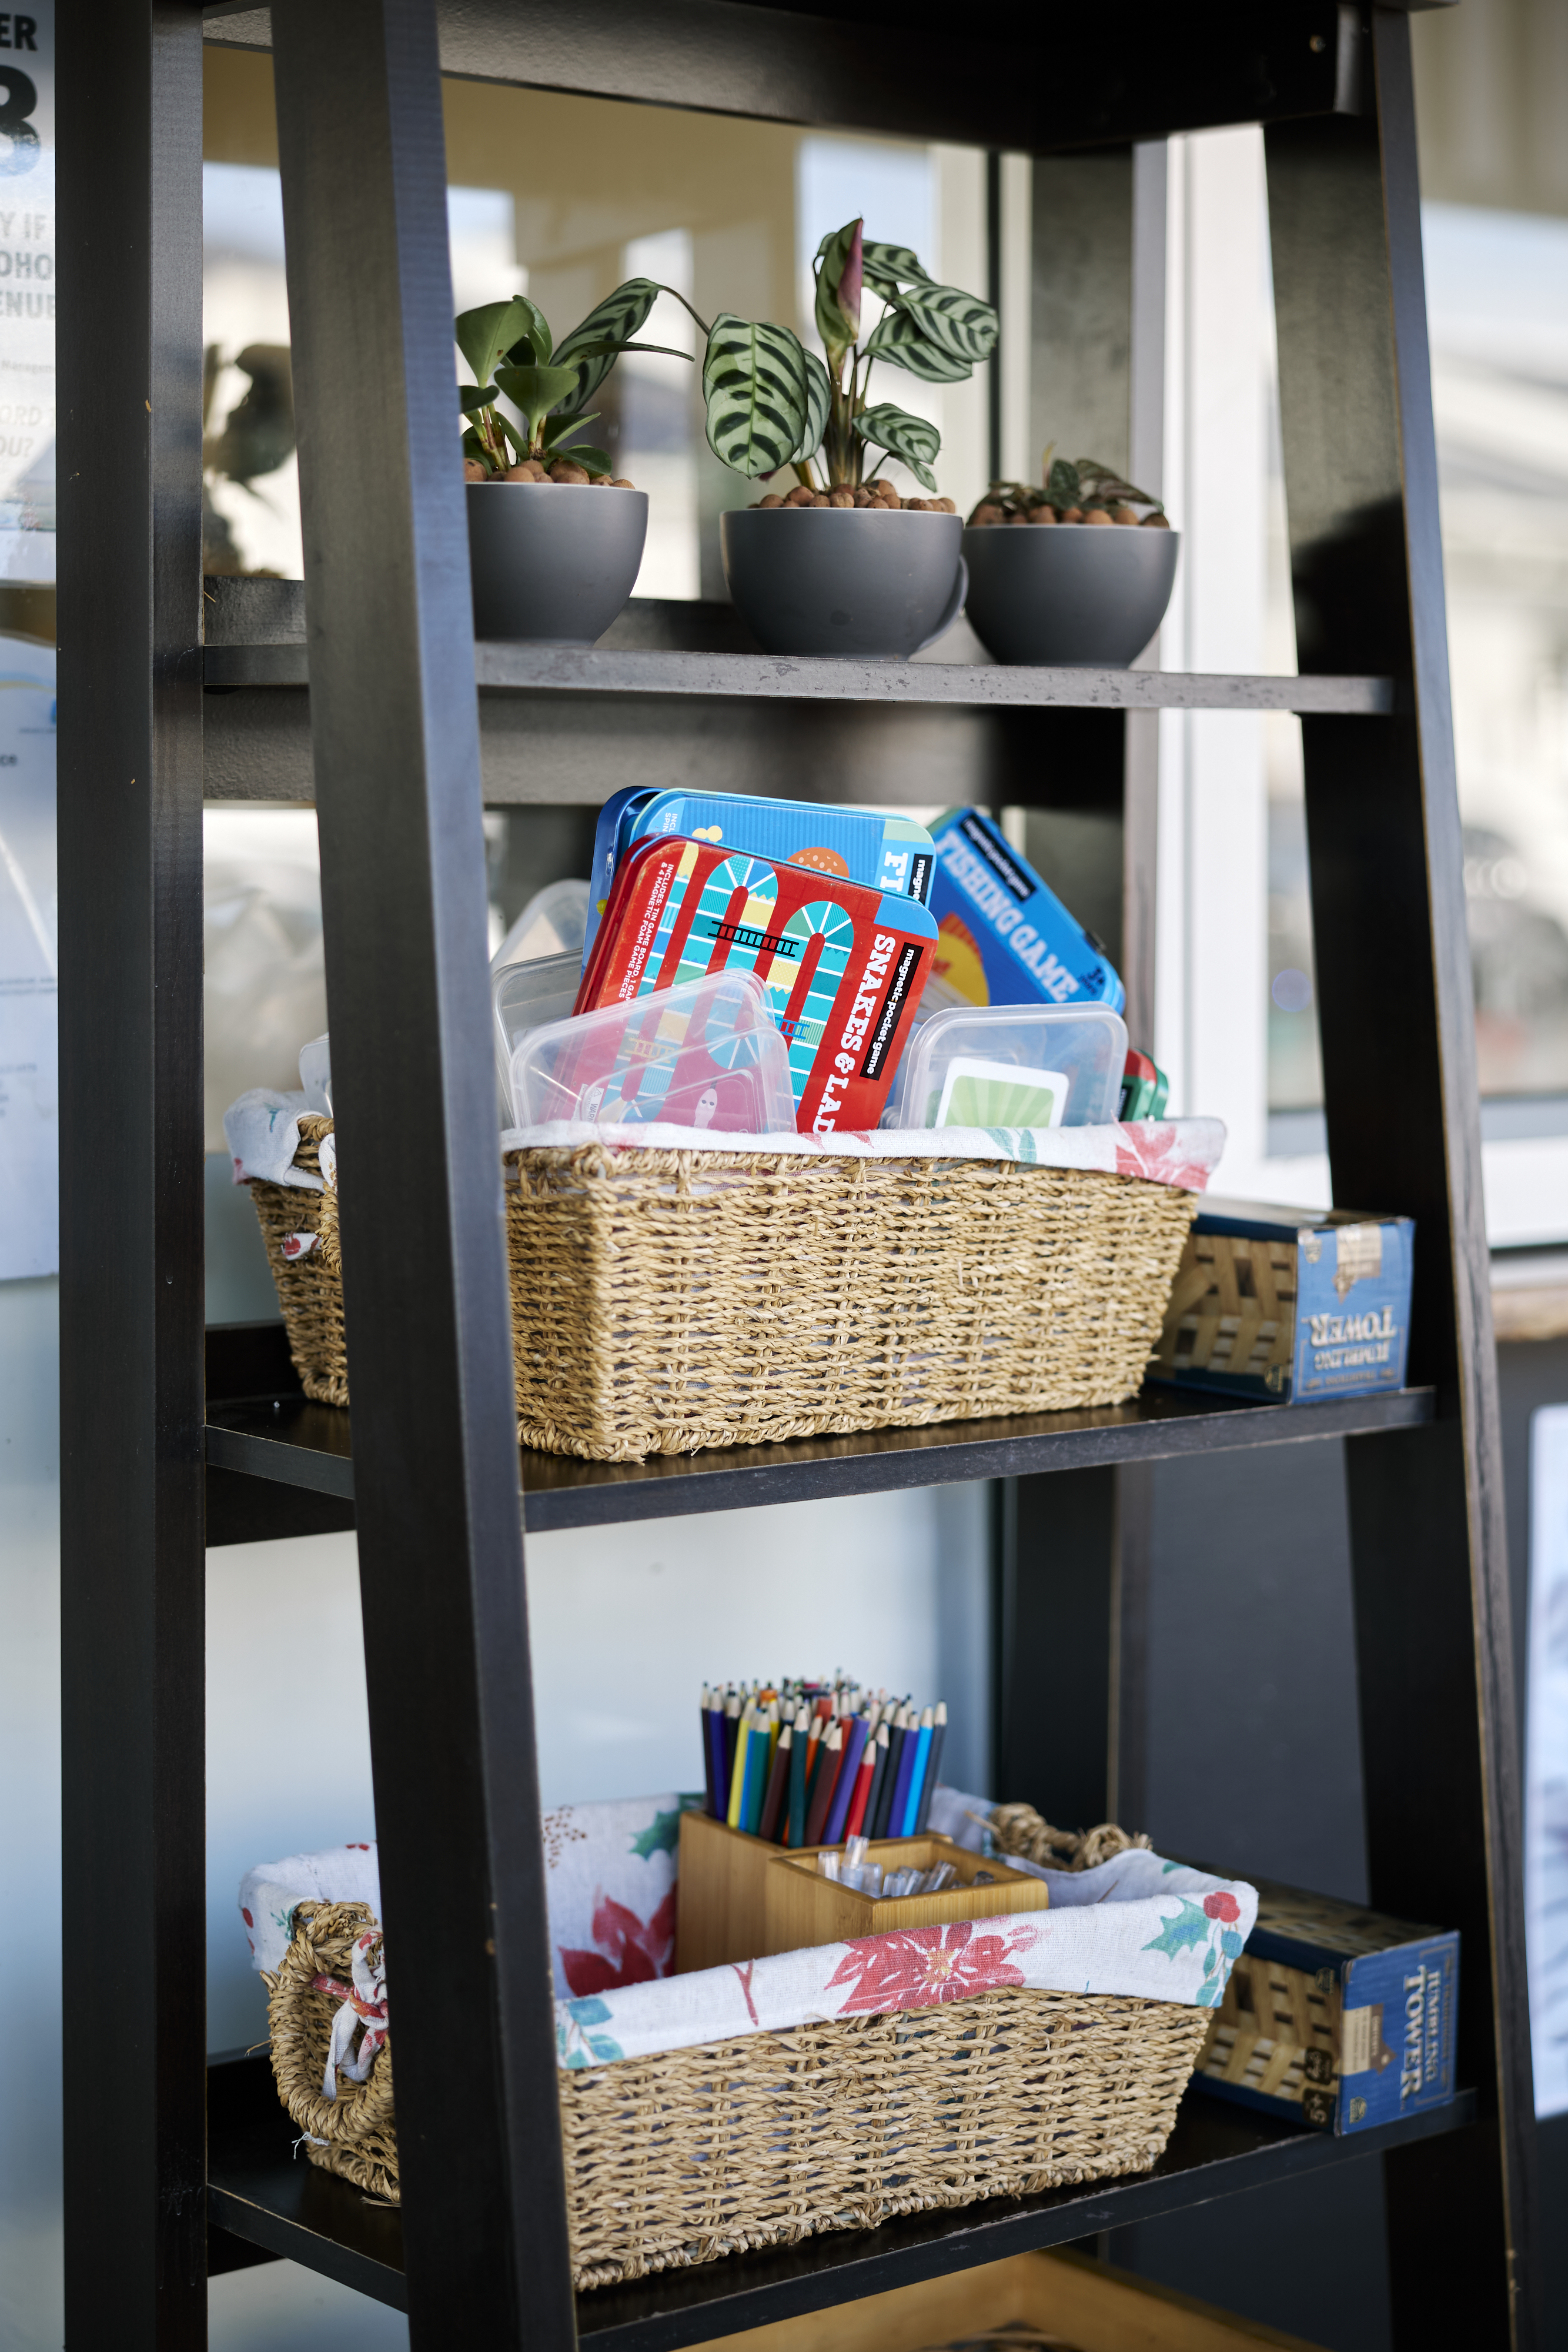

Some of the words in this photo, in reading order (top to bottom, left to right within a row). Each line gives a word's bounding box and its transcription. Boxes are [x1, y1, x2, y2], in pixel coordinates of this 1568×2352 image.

[663, 813, 671, 833] SPIN
[655, 864, 674, 906] INCLUDES:
[880, 851, 908, 892] FI
[644, 877, 663, 919] MAGNETIC
[650, 908, 660, 921] TIN
[935, 830, 1025, 936] FISHING
[1008, 924, 1080, 1004] GAME
[636, 920, 648, 944] FOAM
[642, 922, 654, 946] GAME
[628, 945, 640, 969] GAME
[891, 948, 915, 1003] magnetic
[618, 970, 633, 998] PIECES
[841, 933, 896, 1051] SNAKES
[877, 1001, 897, 1043] pocket
[834, 1052, 855, 1074] &
[867, 1041, 882, 1074] game
[1310, 1304, 1397, 1347] TOWER
[1314, 1339, 1390, 1371] JUMBLING
[1400, 1964, 1426, 2100] TOWER
[1425, 1970, 1440, 2082] JUMBLING
